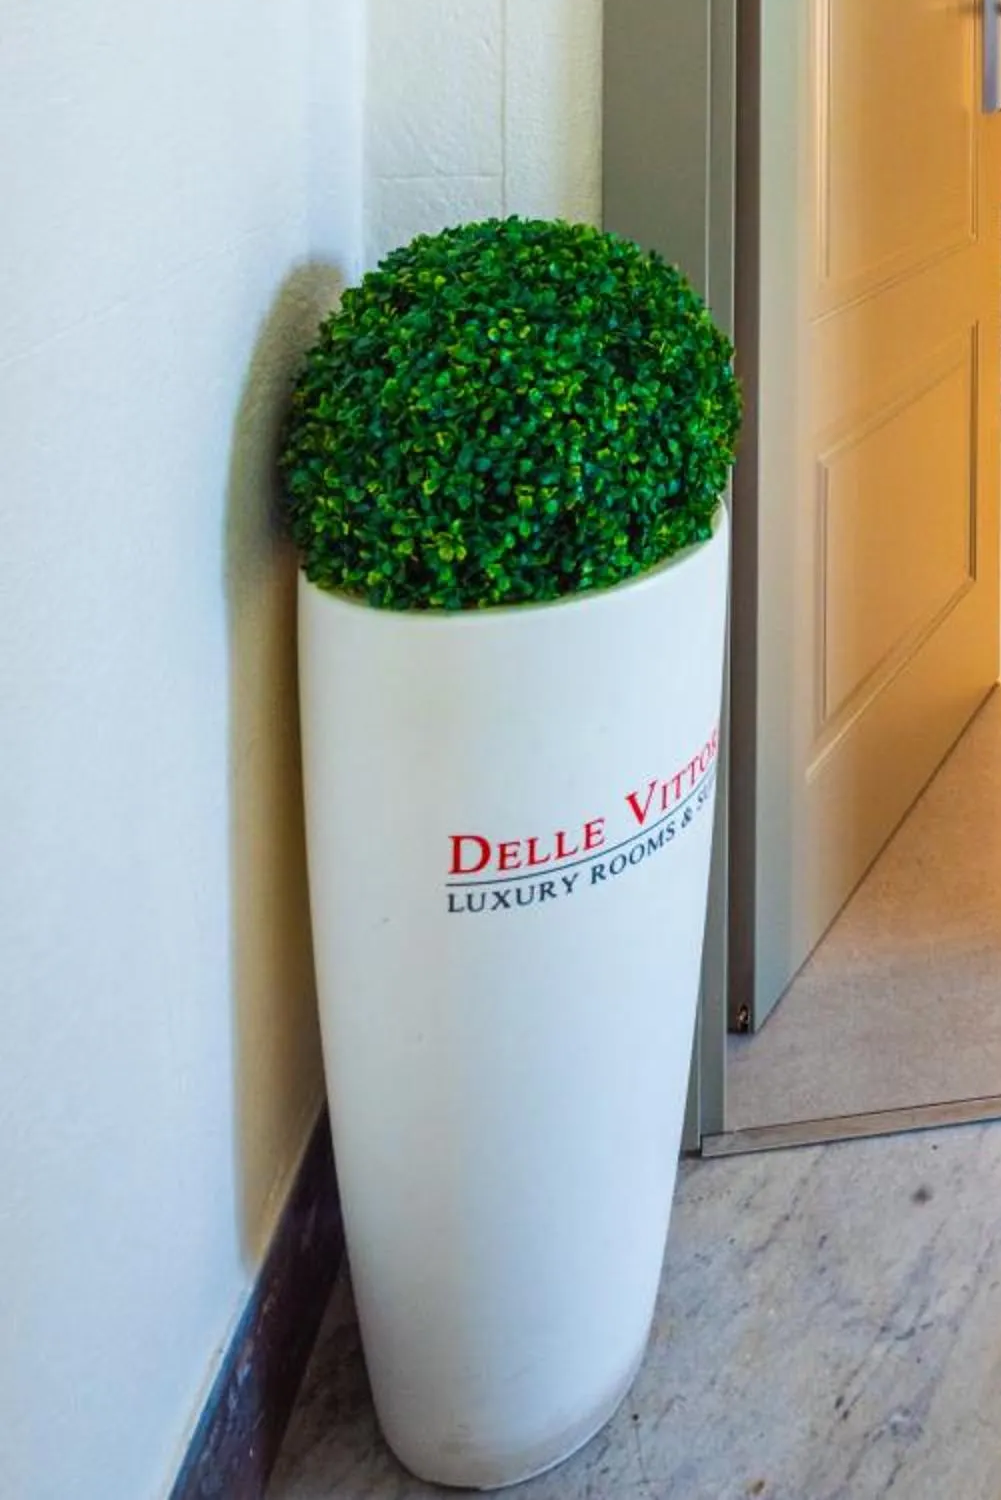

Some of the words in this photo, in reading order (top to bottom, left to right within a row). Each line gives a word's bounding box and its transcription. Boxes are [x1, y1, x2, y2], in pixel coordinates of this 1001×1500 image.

[448, 874, 579, 913] LUXURY
[591, 821, 676, 885] ROOMS
[680, 806, 693, 829] &
